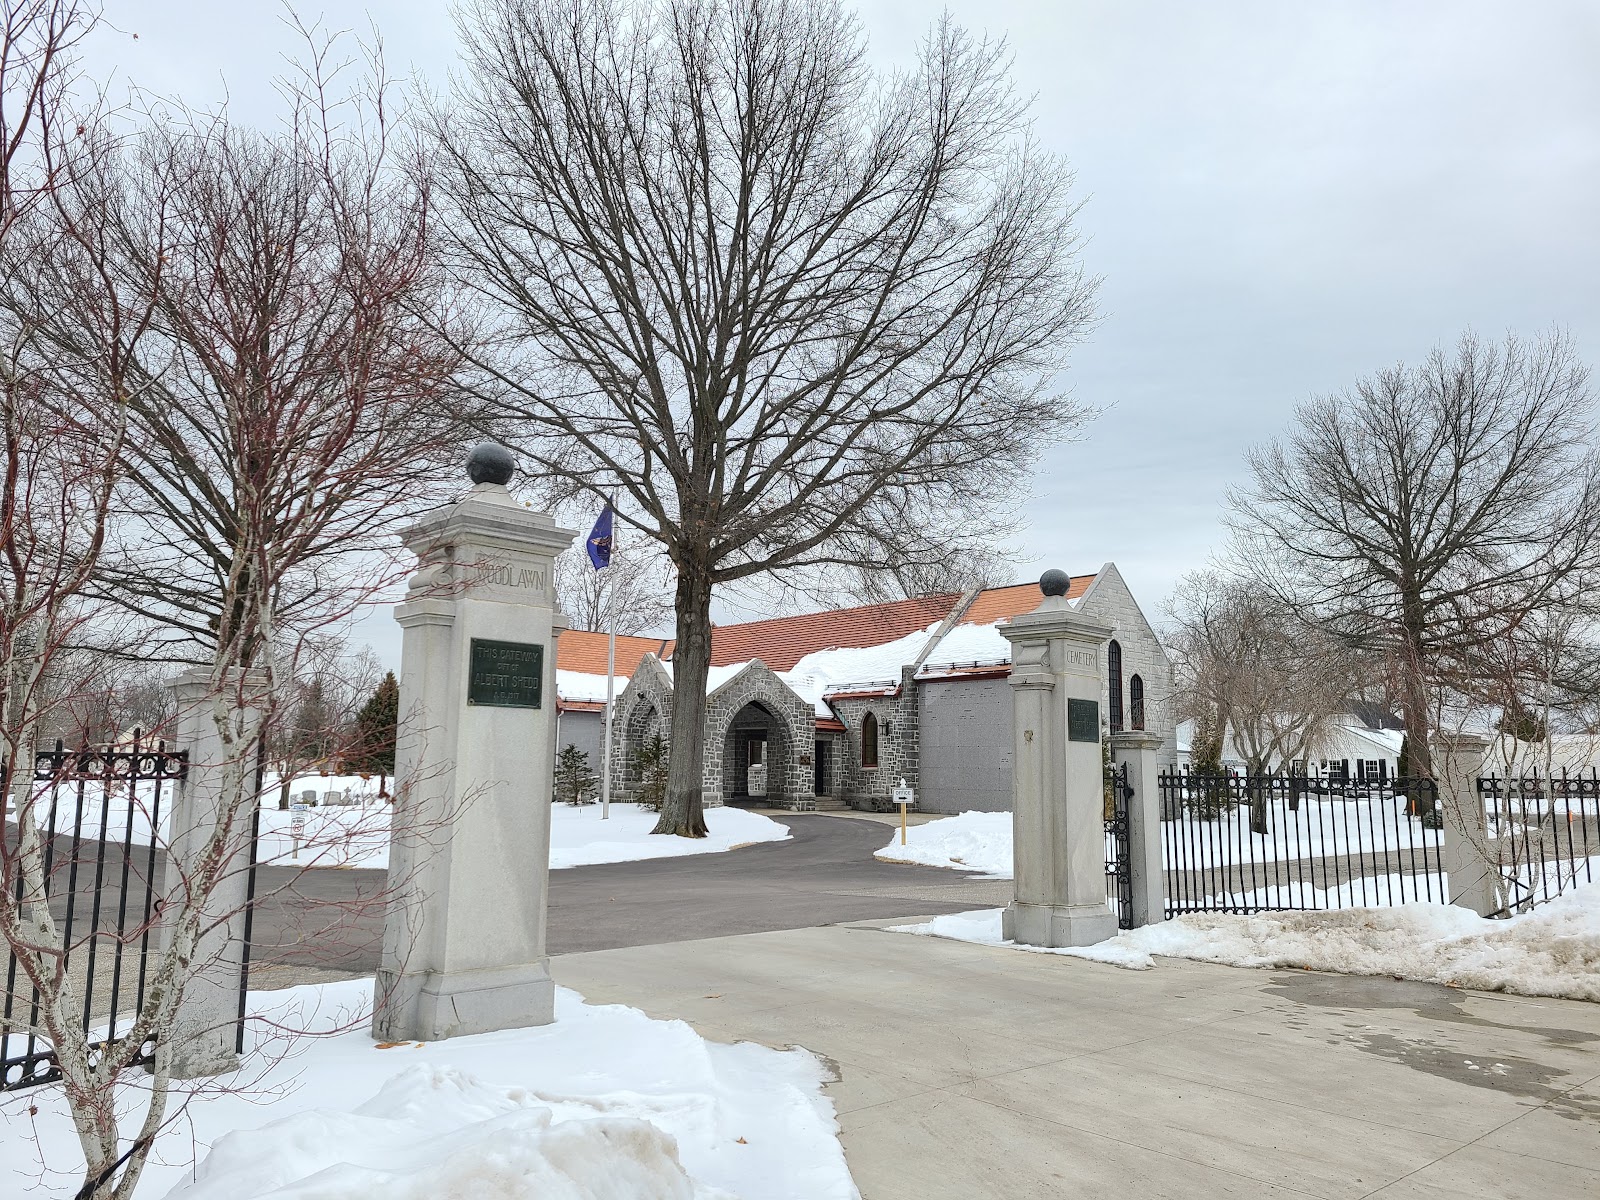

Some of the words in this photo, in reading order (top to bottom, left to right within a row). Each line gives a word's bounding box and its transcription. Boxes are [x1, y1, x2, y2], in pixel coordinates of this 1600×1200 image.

[478, 563, 544, 590] WOODLAWN
[477, 646, 498, 659] THIS
[500, 649, 539, 663] GATEWAY
[1067, 650, 1096, 666] CEMETERY
[474, 672, 510, 687] ALBERT
[511, 675, 539, 690] SHEDD
